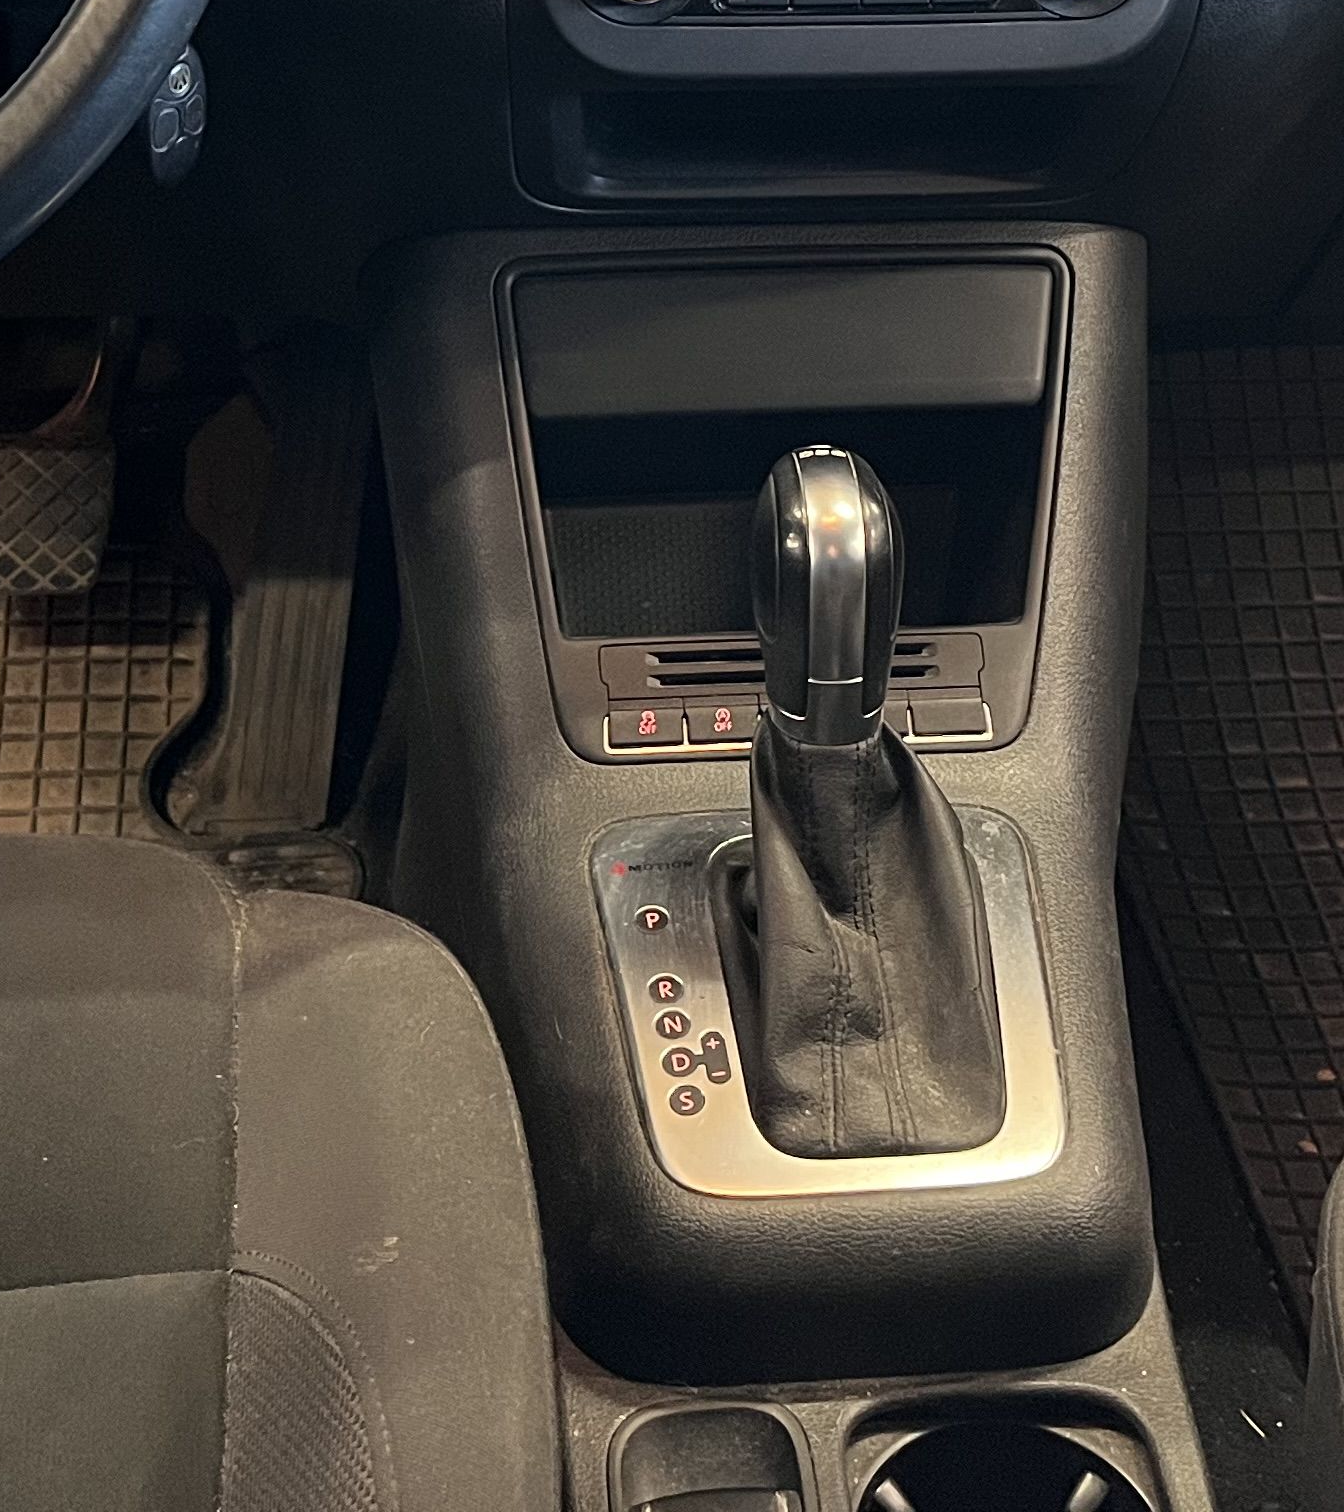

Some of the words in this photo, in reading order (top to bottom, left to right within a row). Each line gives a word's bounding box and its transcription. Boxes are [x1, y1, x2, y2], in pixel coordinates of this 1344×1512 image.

[645, 912, 660, 929] P
[658, 980, 674, 998] R
[663, 1015, 682, 1034] N
[671, 1053, 691, 1072] D
[679, 1091, 695, 1111] S
